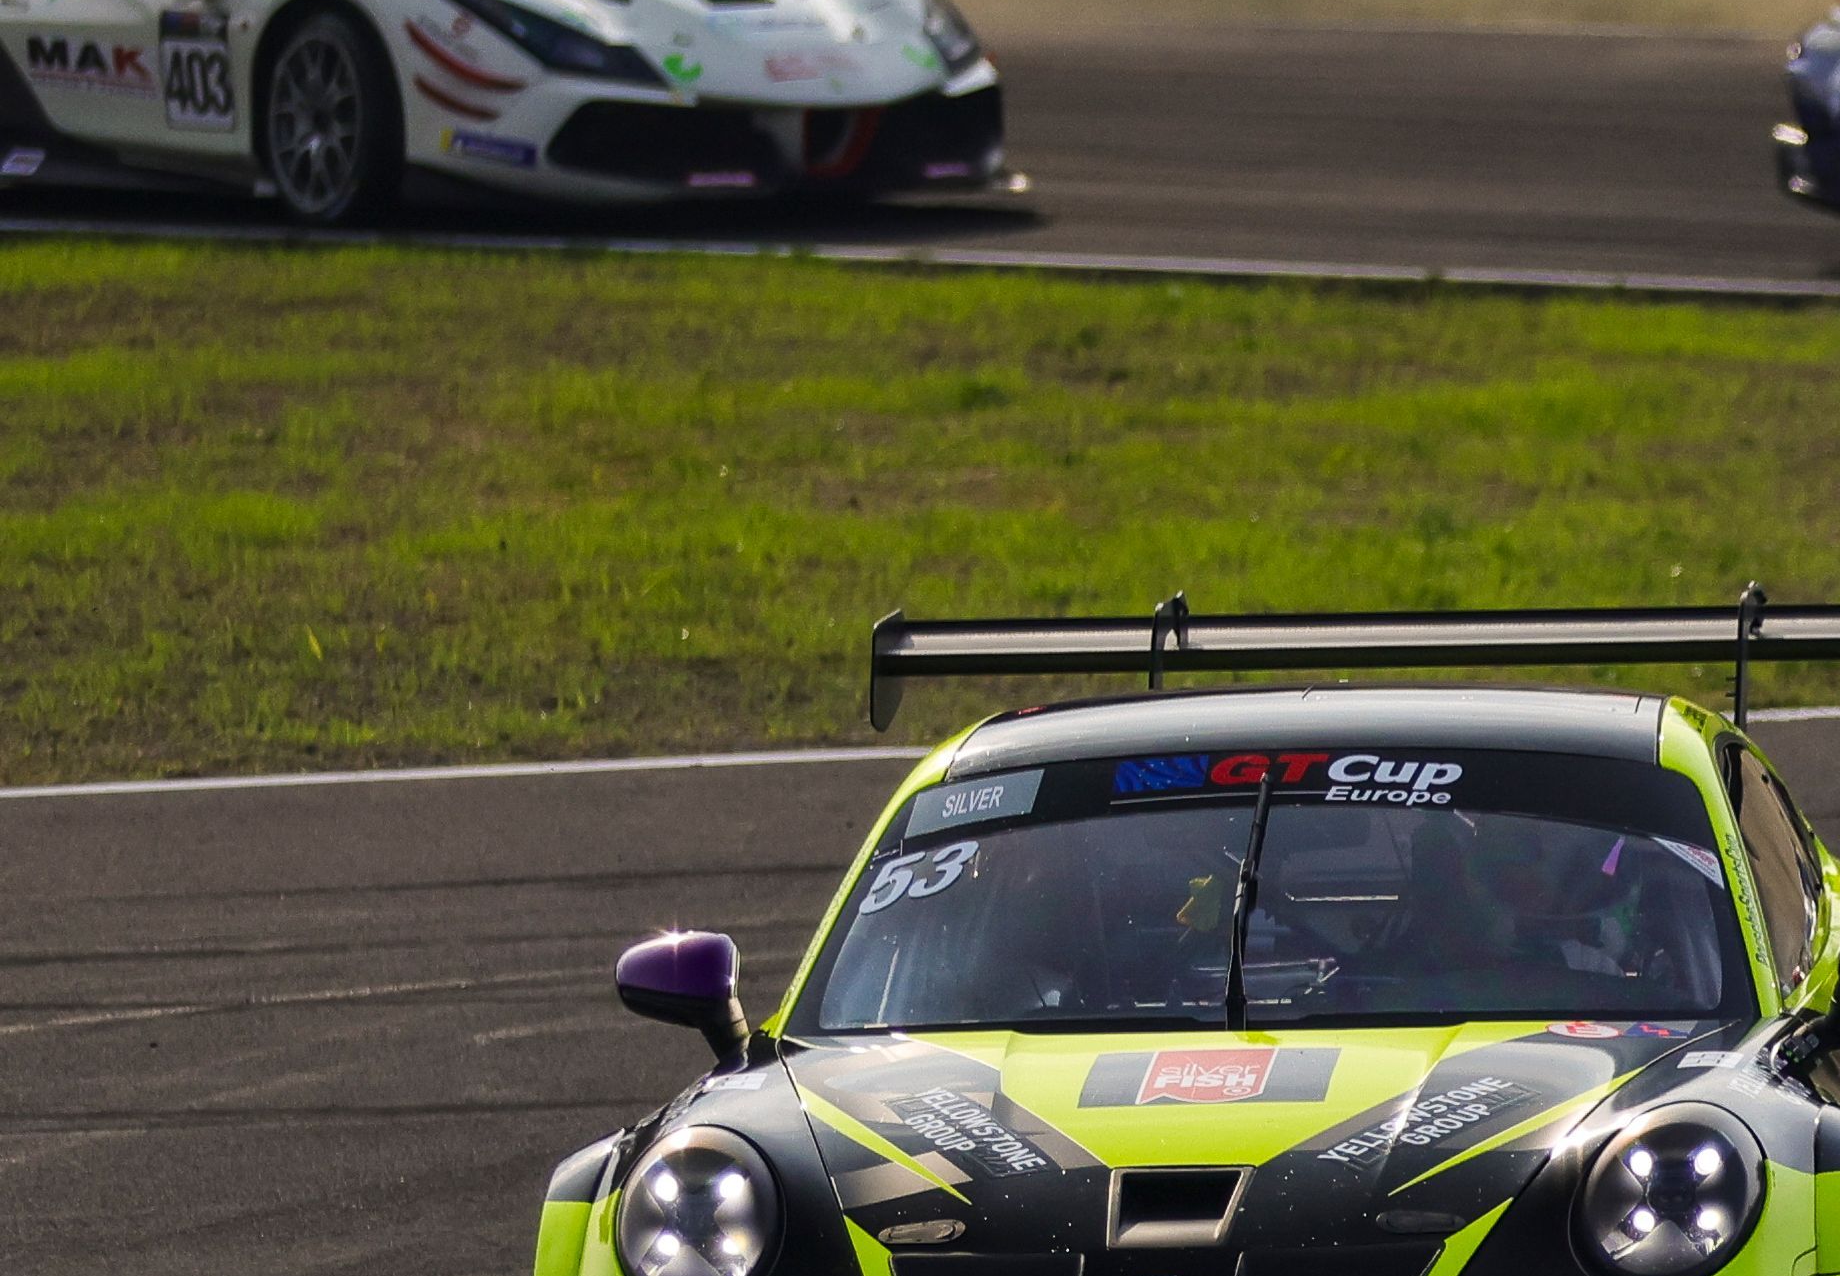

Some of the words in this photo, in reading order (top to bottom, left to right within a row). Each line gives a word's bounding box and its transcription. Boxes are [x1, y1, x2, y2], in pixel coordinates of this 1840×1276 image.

[27, 34, 157, 76] MAK
[167, 47, 232, 116] 403
[1210, 753, 1329, 785] GT
[1326, 754, 1464, 788] Cup
[941, 785, 1005, 820] SILVER
[1324, 785, 1452, 807] Europe
[858, 839, 981, 916] 53
[1153, 1071, 1256, 1089] FISH
[1158, 1060, 1262, 1079] silver
[903, 1111, 976, 1153] GROUP
[923, 1087, 1047, 1173] YELLOWSTONE
[1318, 1077, 1513, 1164] YELLOWSTONE
[1400, 1103, 1487, 1147] GROUP
